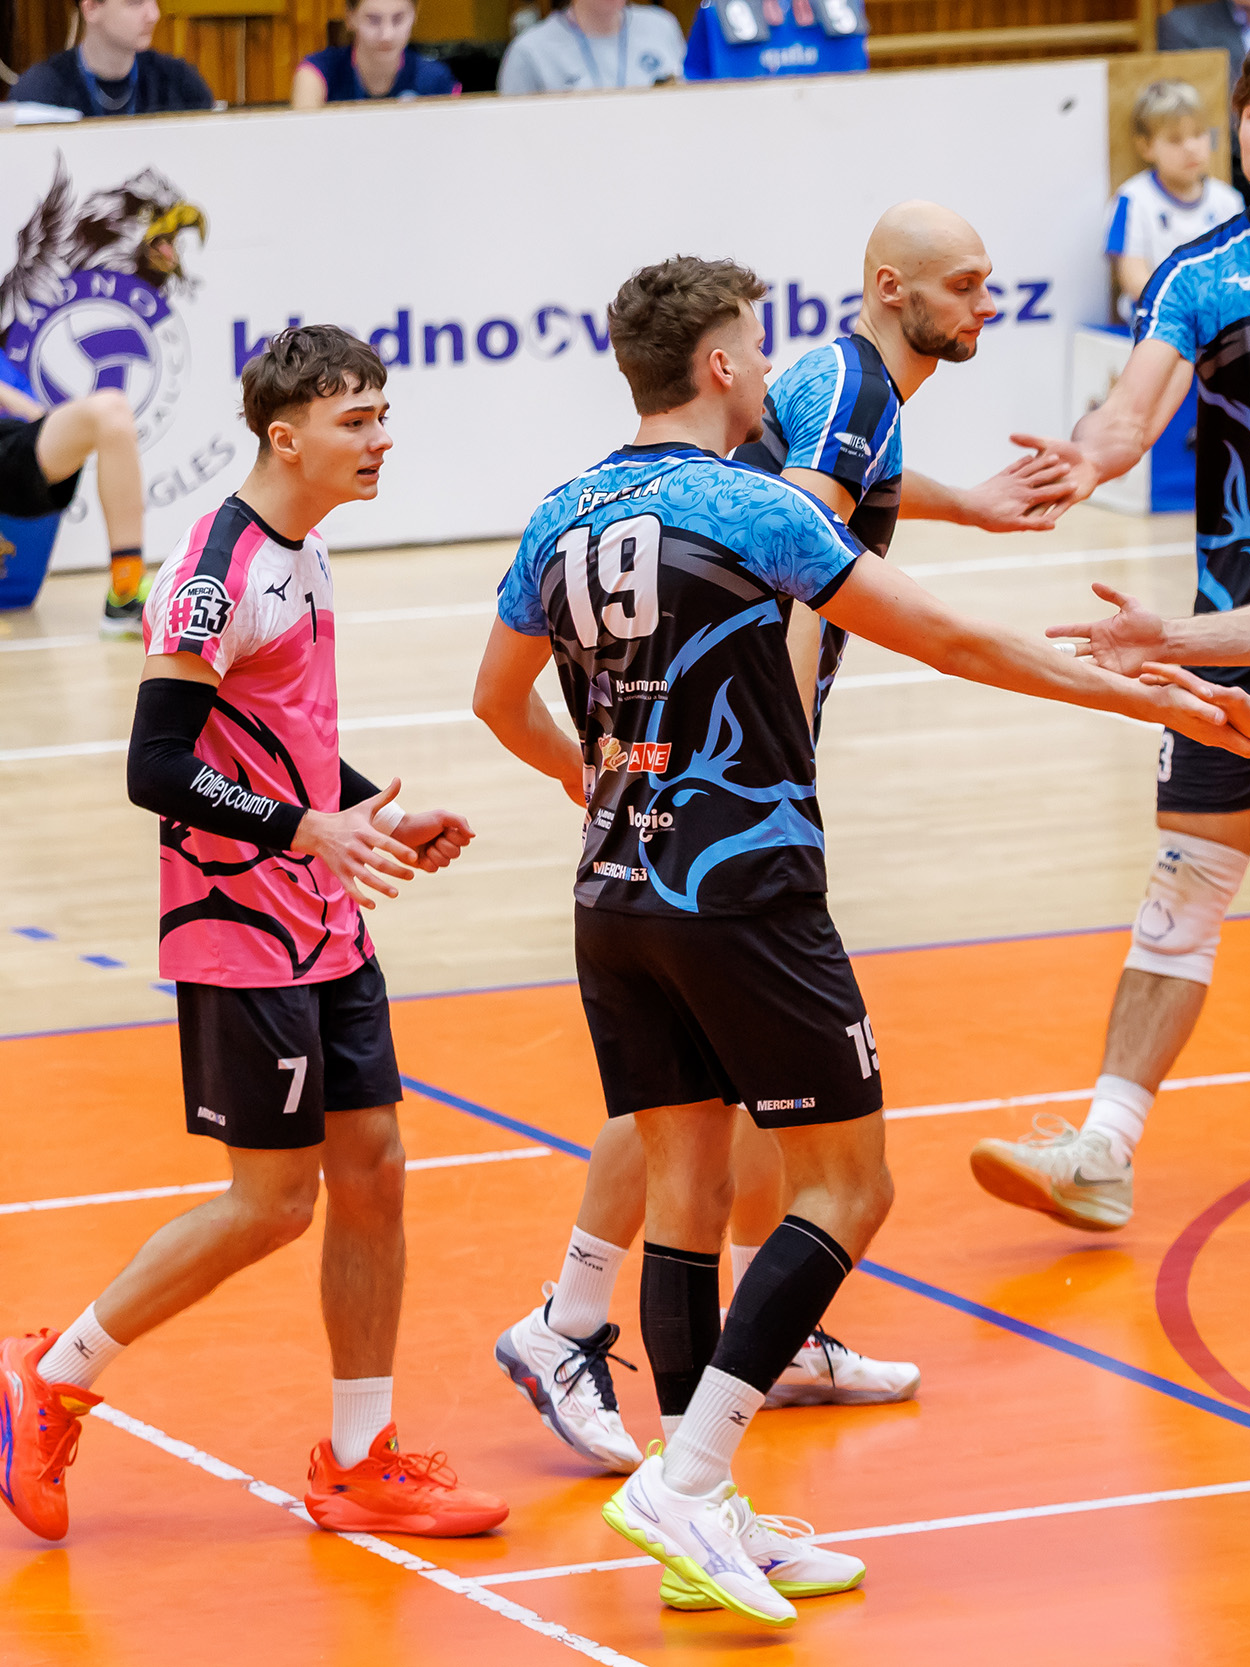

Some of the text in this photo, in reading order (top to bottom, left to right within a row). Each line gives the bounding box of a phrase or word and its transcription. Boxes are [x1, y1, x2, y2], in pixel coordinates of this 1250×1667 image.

[187, 586, 215, 596] MERCH
[556, 514, 662, 649] 19
[169, 595, 232, 635] #53
[190, 764, 280, 822] VolleyCountry
[277, 1056, 307, 1114] 7
